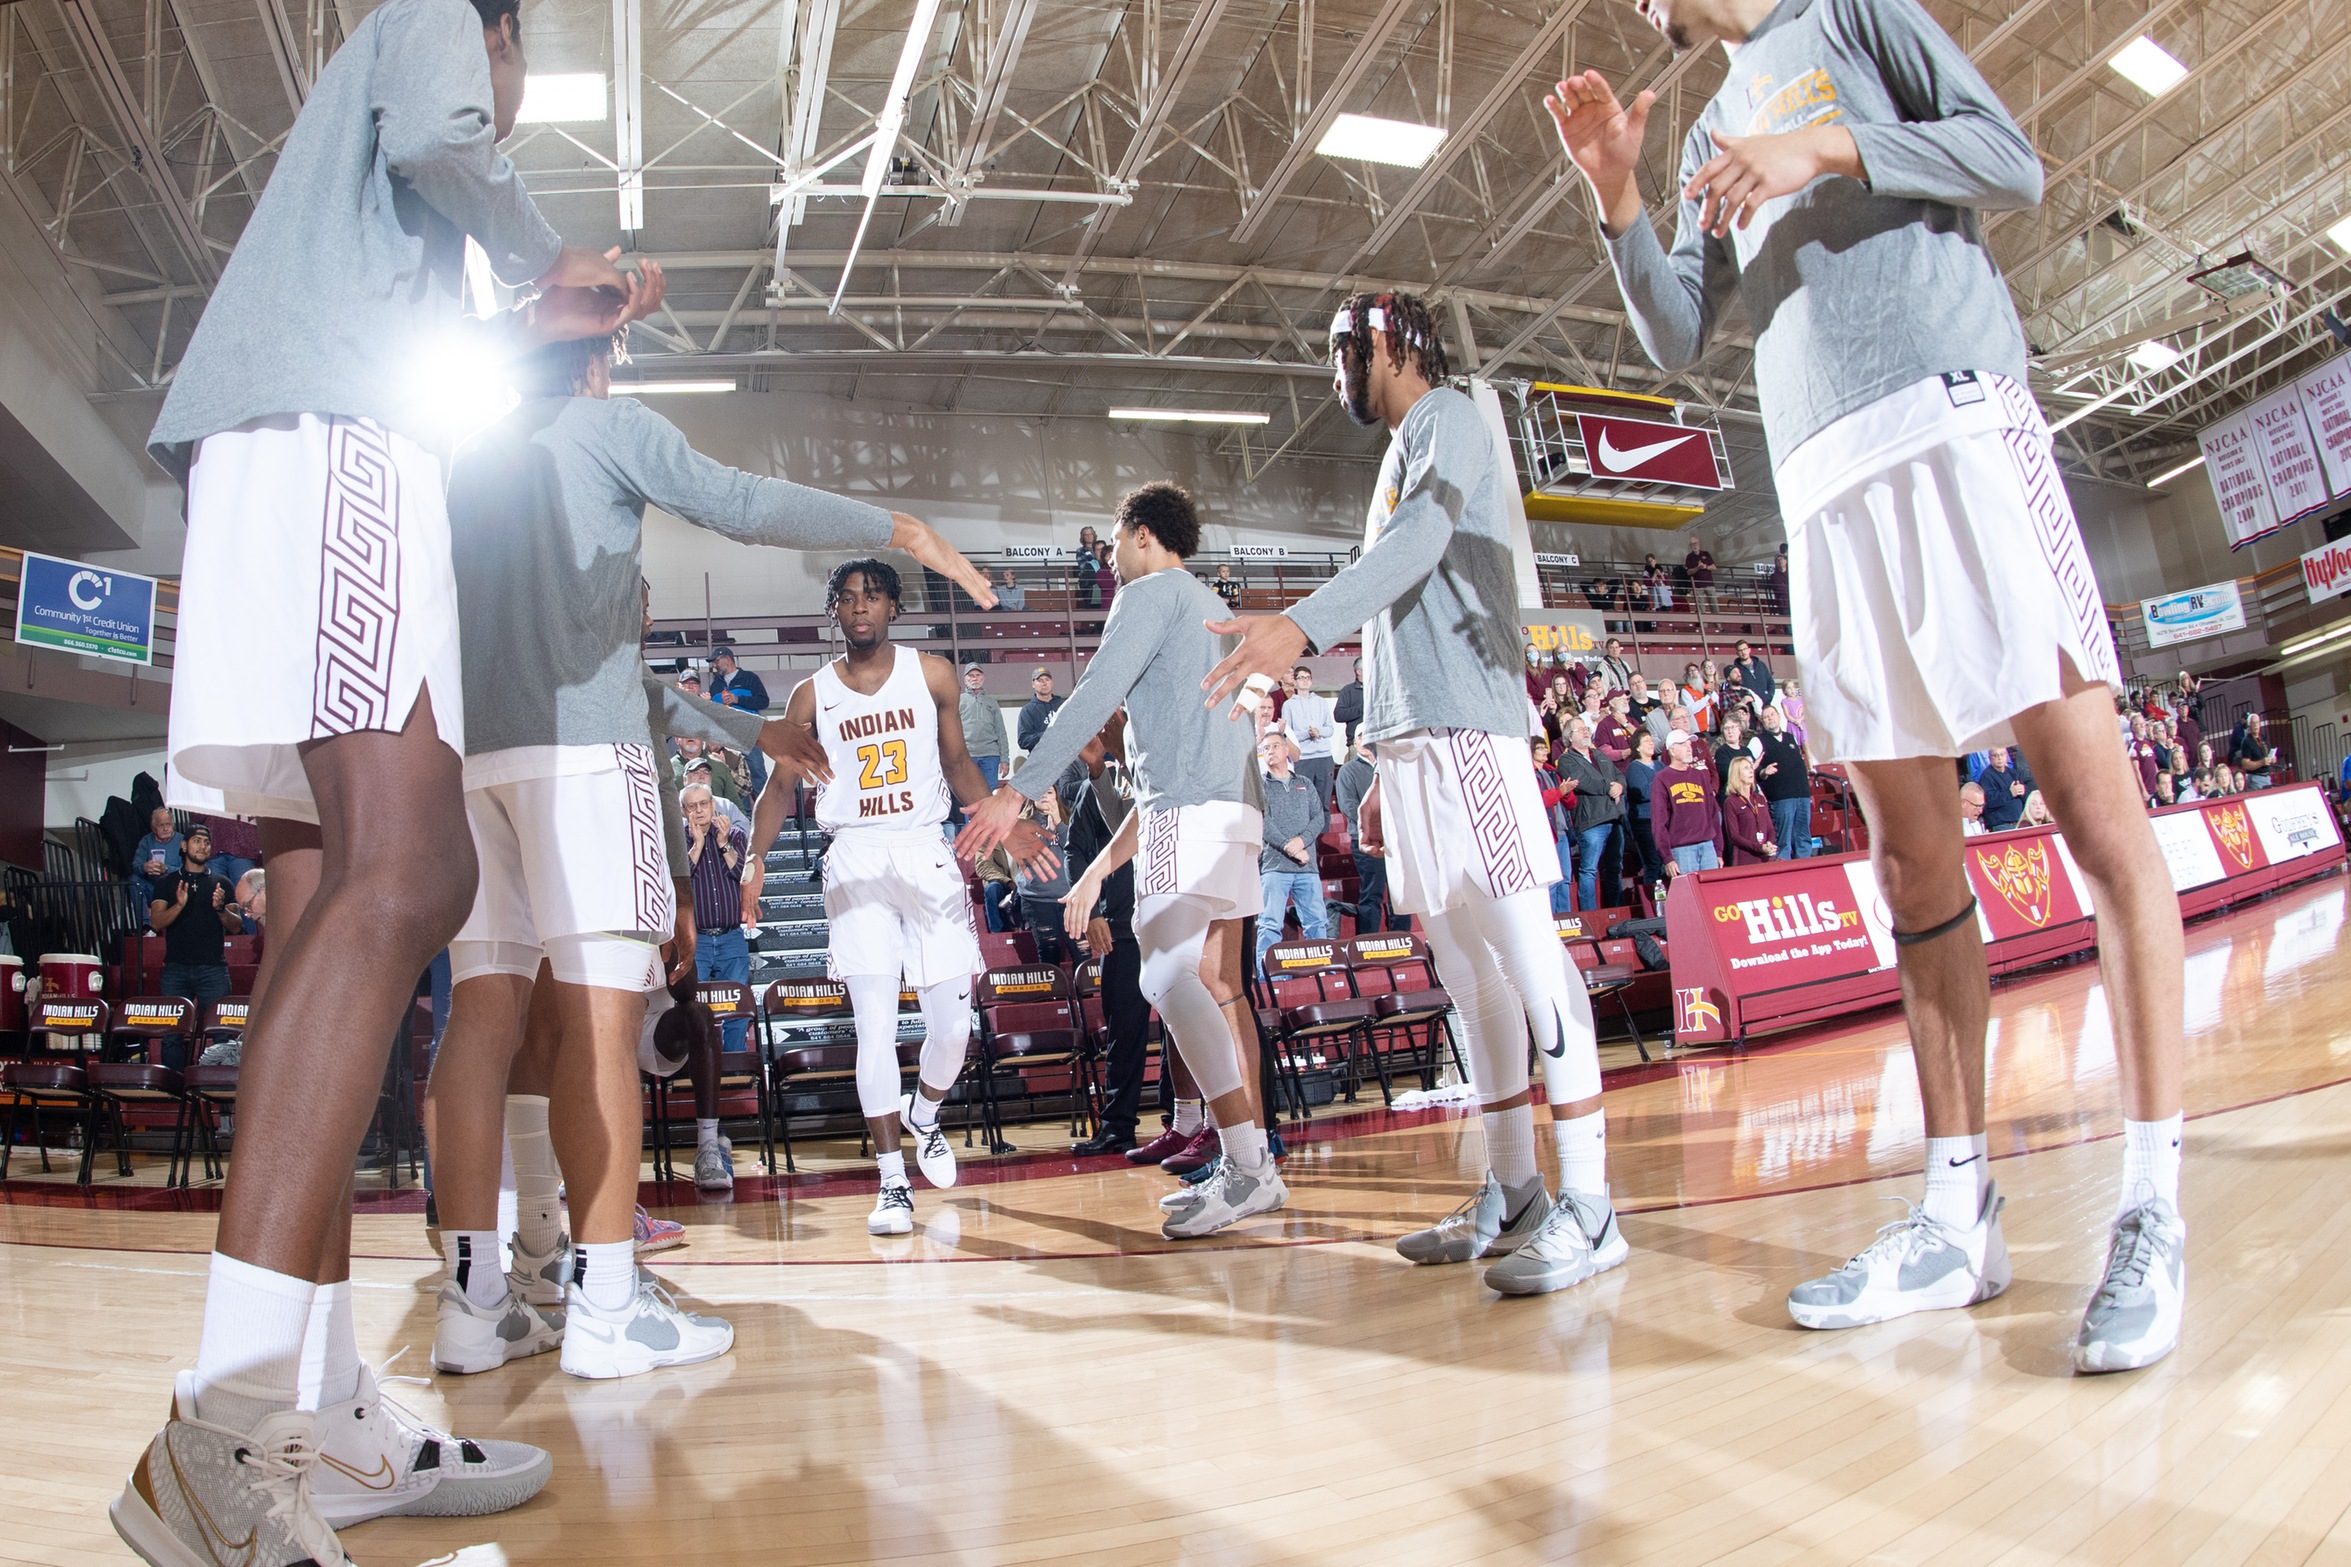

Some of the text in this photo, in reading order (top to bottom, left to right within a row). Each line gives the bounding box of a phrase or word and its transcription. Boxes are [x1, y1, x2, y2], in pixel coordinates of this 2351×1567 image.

[1950, 370, 1970, 383] XL
[2306, 372, 2346, 402] NJCAA
[2255, 401, 2298, 431] NJCAA
[2322, 408, 2351, 433] NATIONAL
[2205, 426, 2248, 456] NJCAA
[2270, 442, 2306, 468] NATIONAL
[2219, 468, 2256, 494] NATIONAL
[2272, 458, 2314, 487] CHAMPIONS
[2222, 484, 2264, 513] CHAMPIONS
[2290, 480, 2307, 498] 2011
[1006, 547, 1062, 556] BALCONY A
[1234, 547, 1274, 556] BALCONY
[1537, 554, 1568, 564] BALCONY
[34, 605, 139, 633] Community 1st Credit Union
[85, 626, 112, 639] Together
[120, 633, 138, 642] Better
[1528, 625, 1592, 650] Hills
[839, 708, 915, 742] INDIAN
[857, 738, 908, 790] 23
[859, 790, 914, 818] HILLS
[1560, 918, 1582, 930] HILLS
[1714, 893, 1858, 945] GO Hills TV
[1274, 945, 1333, 960] INDIAN HILLS
[1356, 937, 1413, 952] INDIAN HILLS
[1730, 935, 1869, 970] Download the App Today!
[990, 970, 1055, 985] INDIAN HILLS
[711, 989, 741, 1003] HILLS
[777, 984, 846, 998] INDIAN HILLS
[42, 1004, 99, 1017] INDIAN HILLS
[124, 1003, 184, 1017] INDIAN HILLS
